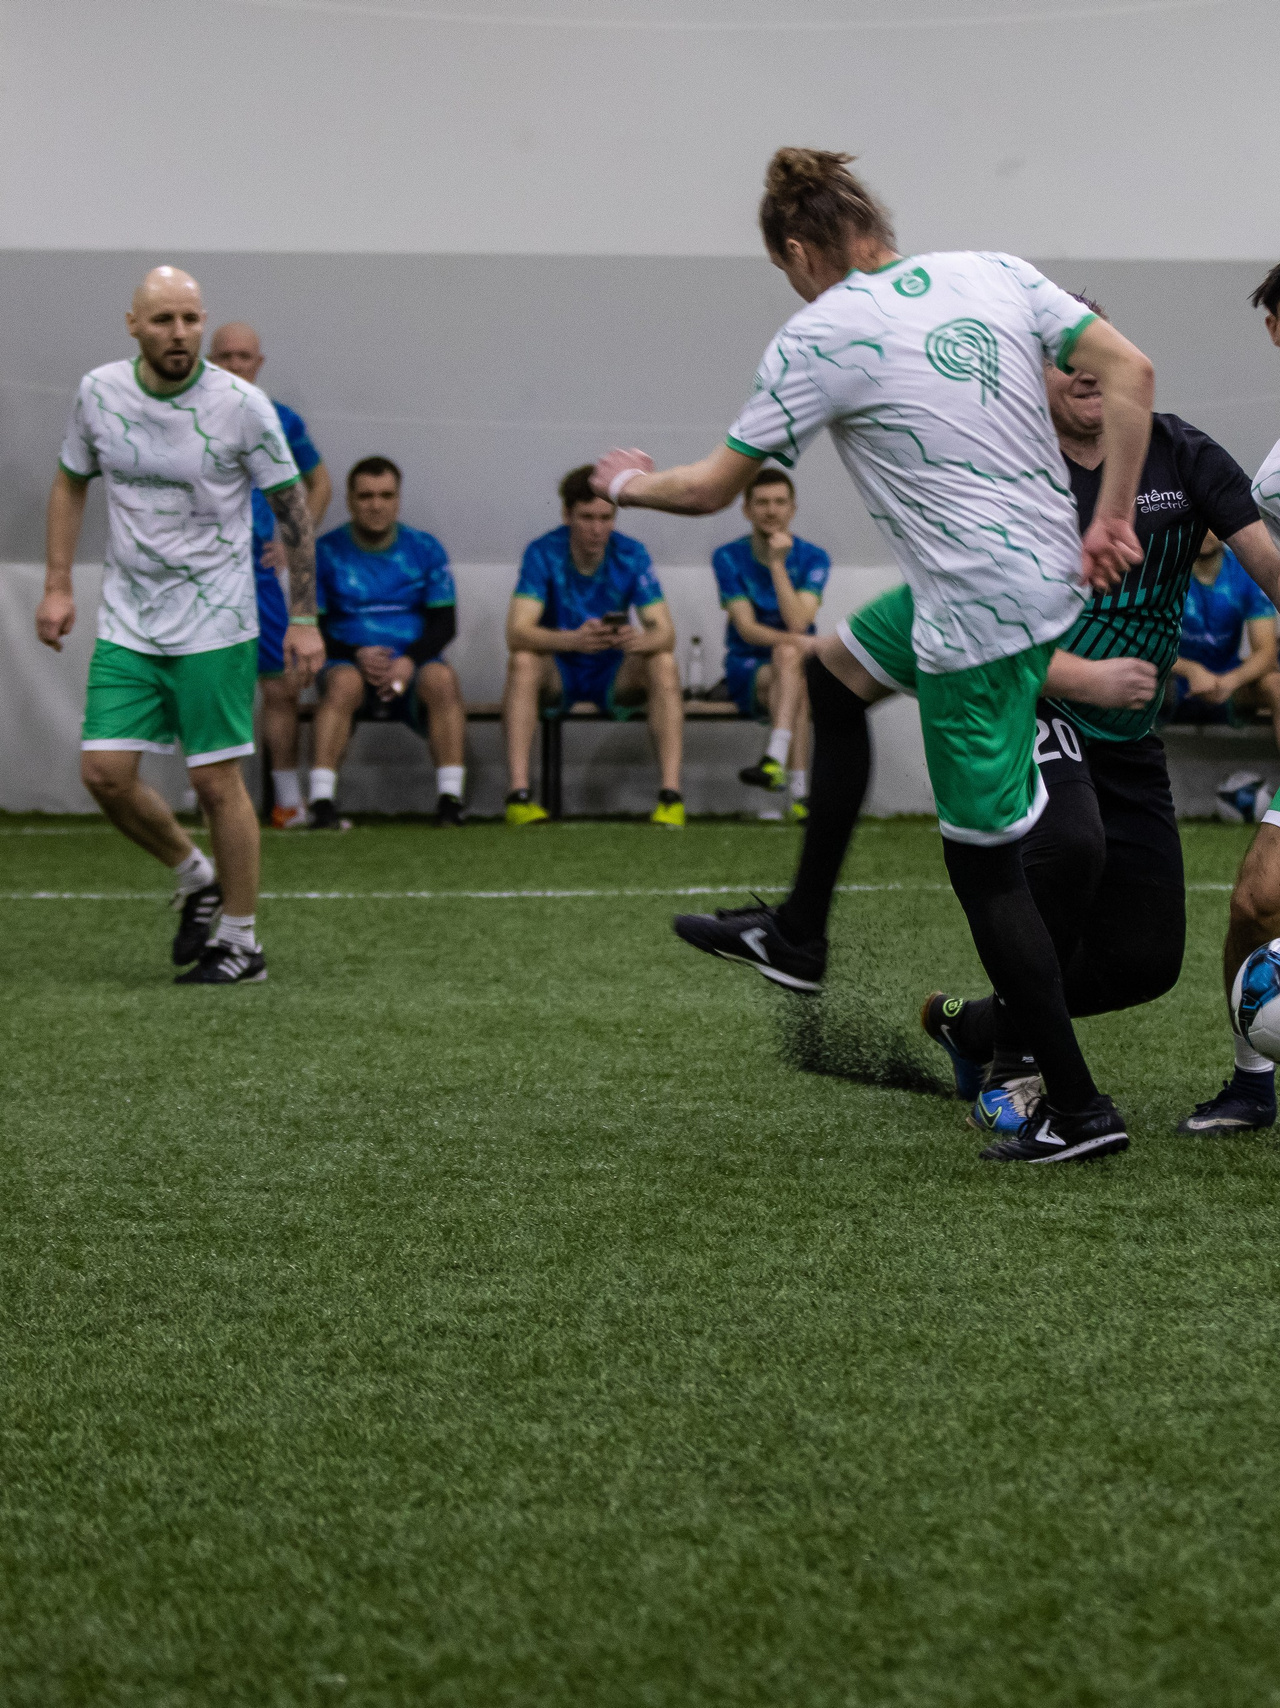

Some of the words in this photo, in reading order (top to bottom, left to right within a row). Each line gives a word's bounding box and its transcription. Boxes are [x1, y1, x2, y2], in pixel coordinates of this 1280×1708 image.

[1135, 489, 1184, 505] stême
[1140, 499, 1190, 514] electric
[1032, 718, 1083, 765] 20
